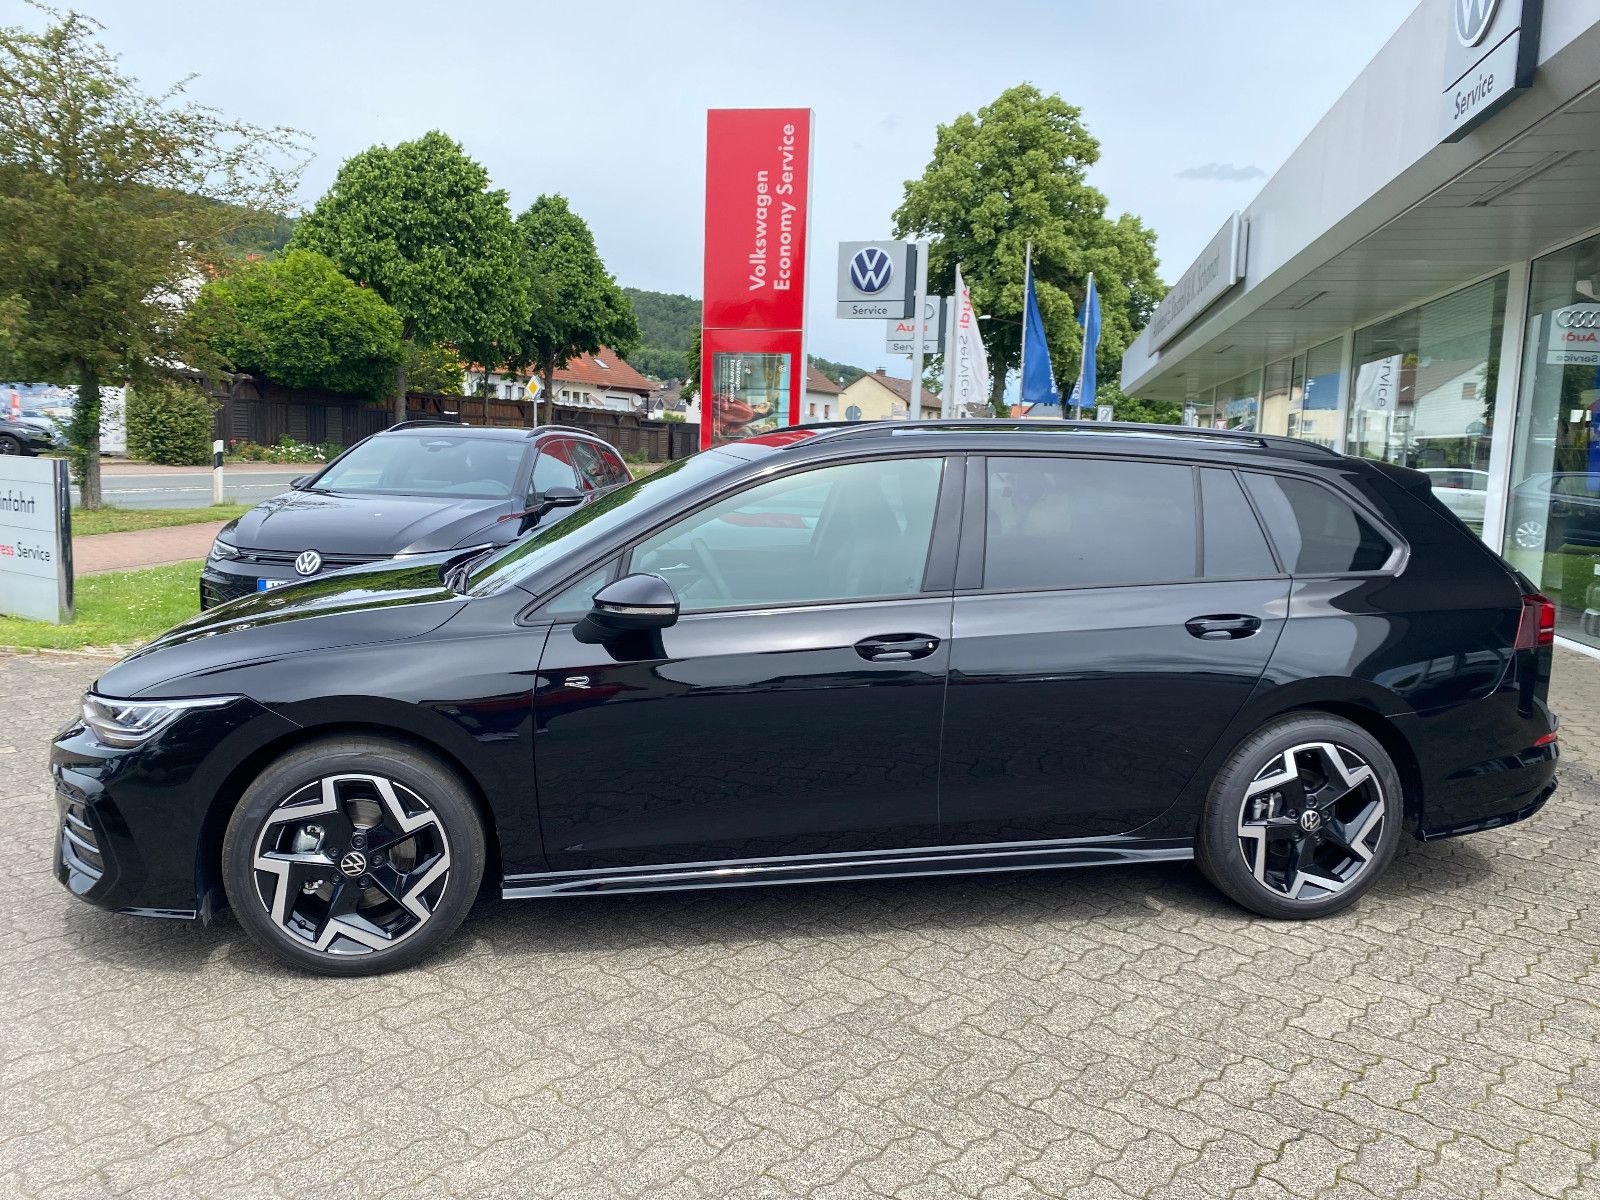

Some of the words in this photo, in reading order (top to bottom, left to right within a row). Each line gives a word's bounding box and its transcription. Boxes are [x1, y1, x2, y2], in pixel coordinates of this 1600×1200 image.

[1454, 73, 1494, 120] Service
[776, 123, 795, 195] Service
[749, 170, 772, 291] Volkswagen
[773, 201, 797, 291] Economy
[849, 247, 893, 295] VW
[852, 305, 888, 315] Service
[895, 322, 929, 332] Aui
[893, 343, 930, 351] Serve
[0, 544, 14, 556] ess
[17, 541, 50, 561] Service
[296, 551, 321, 575] VW
